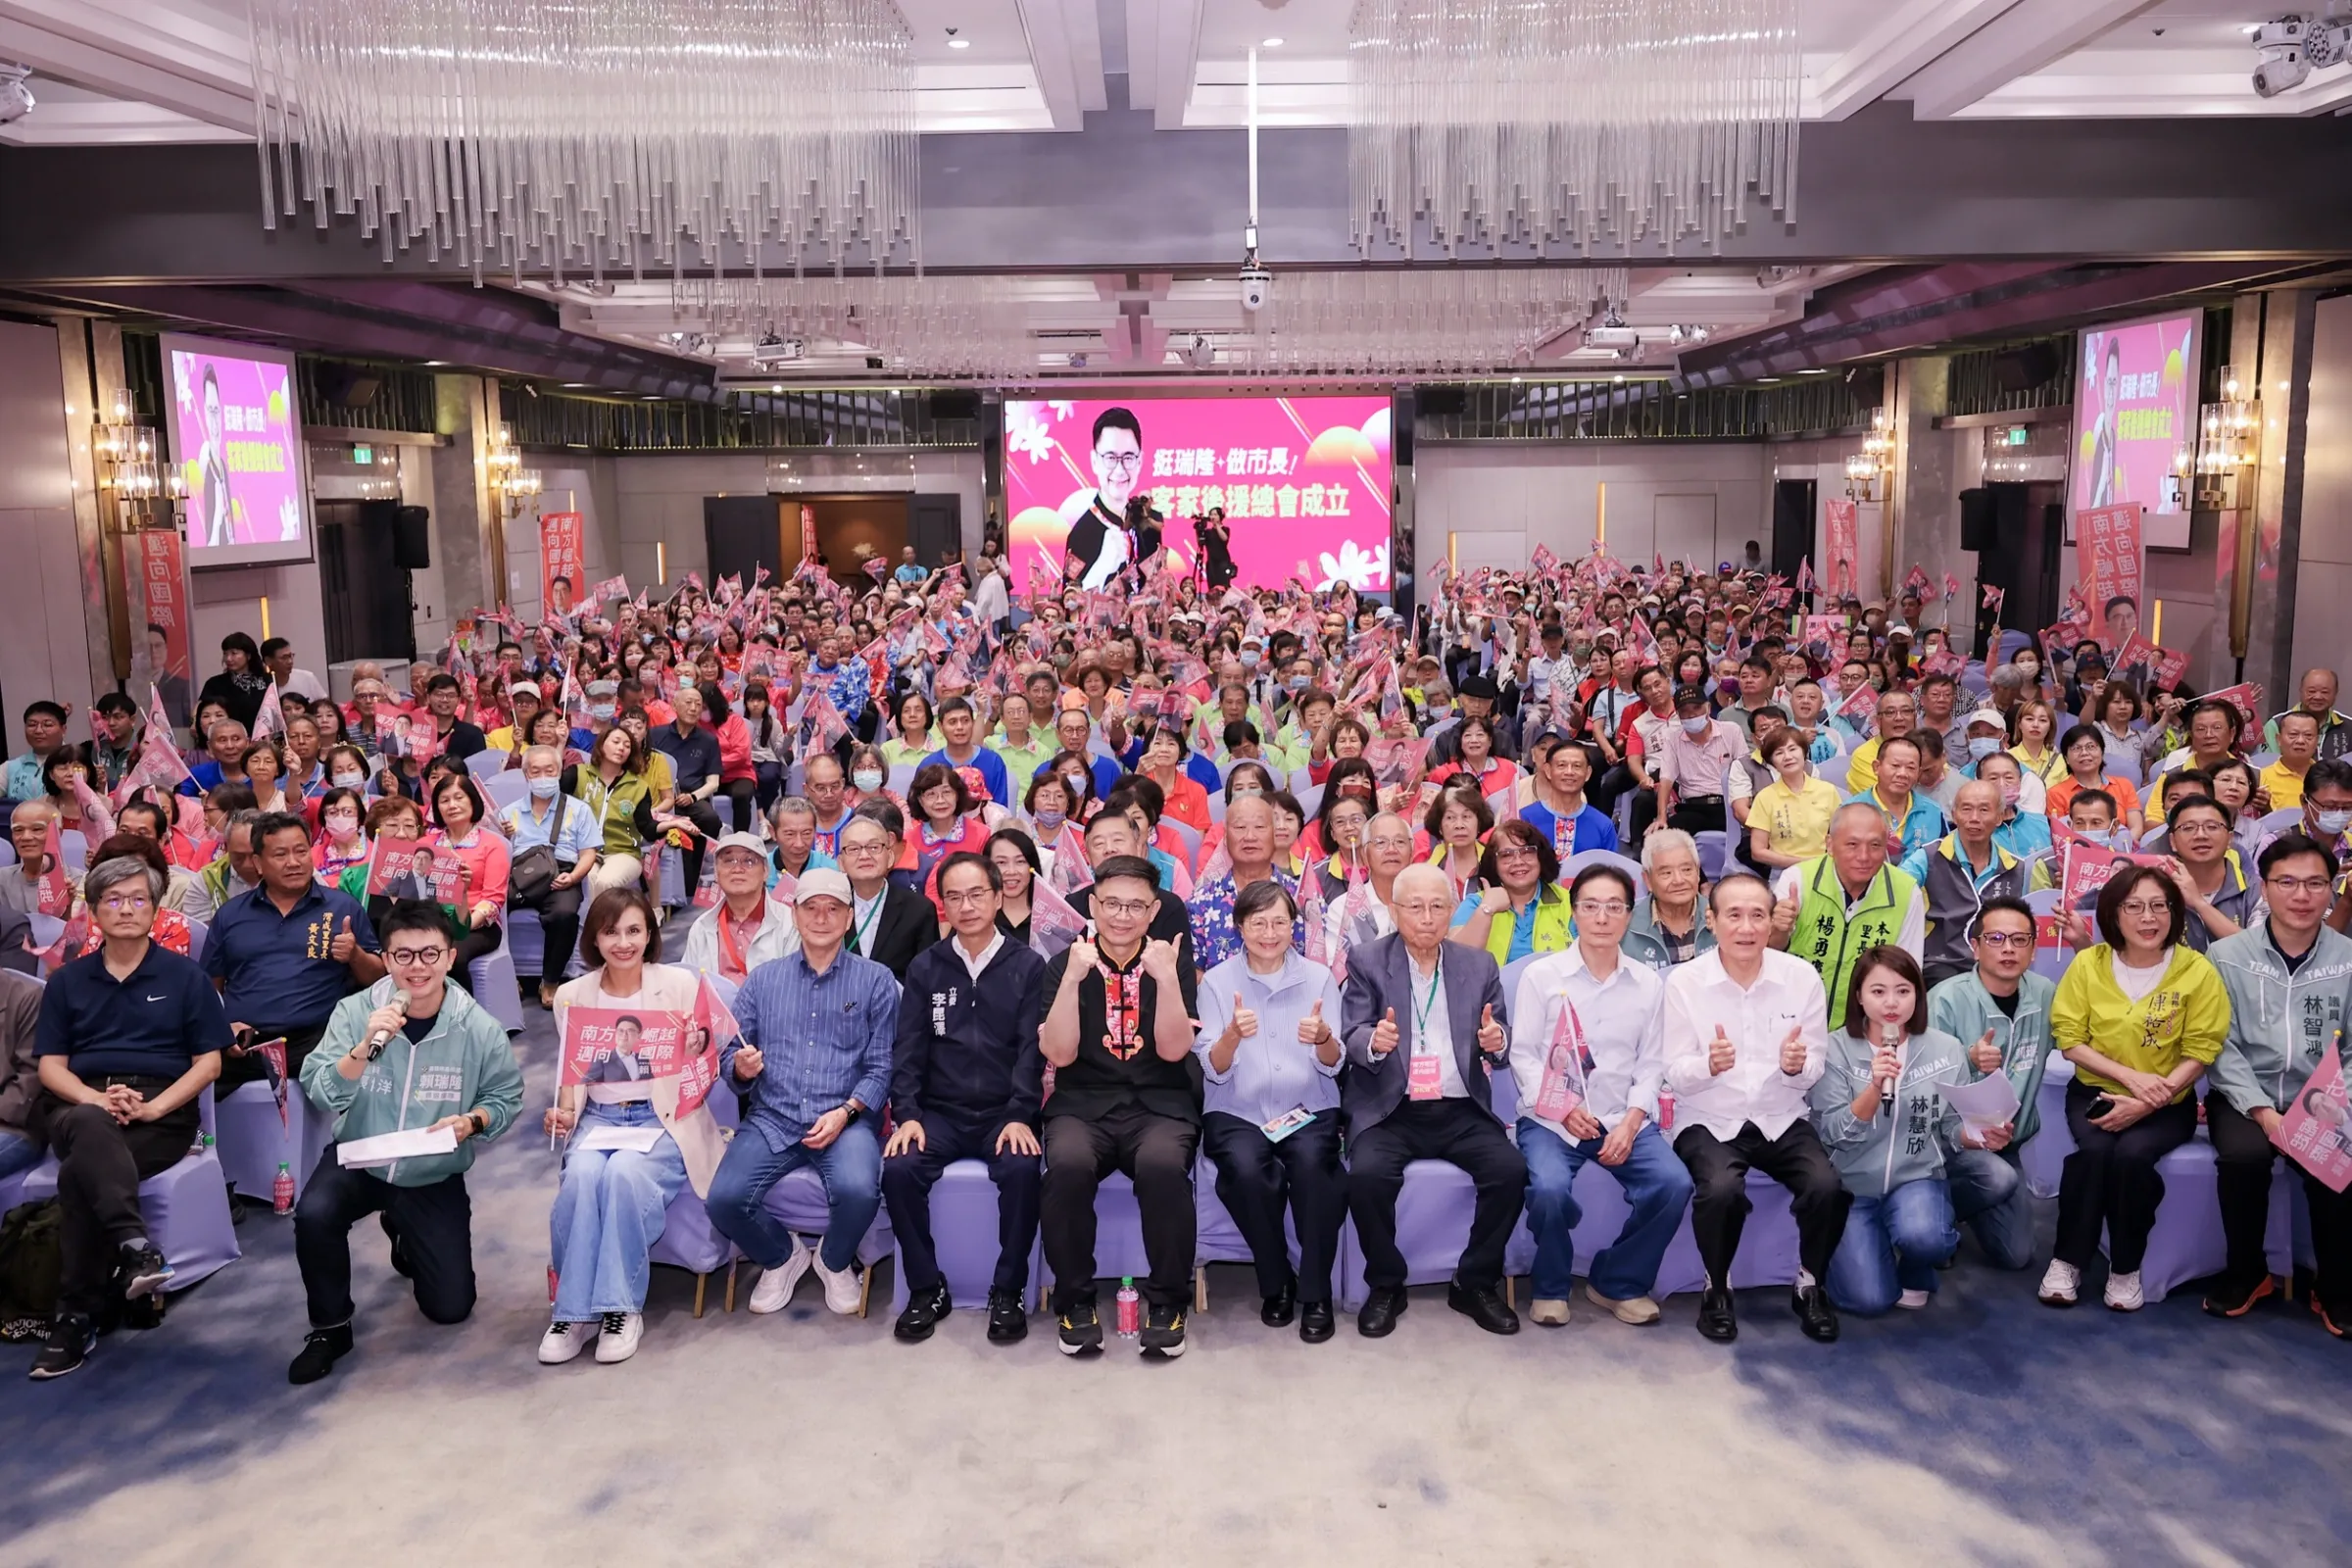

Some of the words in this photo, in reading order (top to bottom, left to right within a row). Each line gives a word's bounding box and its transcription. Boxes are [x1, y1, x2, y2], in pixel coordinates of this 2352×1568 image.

[1151, 483, 1350, 517] 客家後援總會成立
[2079, 861, 2111, 878] 南方
[307, 922, 320, 959] 黃文良
[2248, 959, 2280, 979] TEAM
[2305, 959, 2352, 980] TAIWAN
[931, 992, 947, 1037] 李昆澤
[2303, 995, 2325, 1057] 林智鴻
[580, 1024, 615, 1043] 南方
[641, 1027, 678, 1044] 崛起
[575, 1045, 612, 1063] 邁向
[638, 1044, 675, 1060] 國際
[1852, 1065, 1874, 1079] TE
[1908, 1055, 1950, 1080] TAIWAN
[1906, 1095, 1929, 1155] 林慧欣
